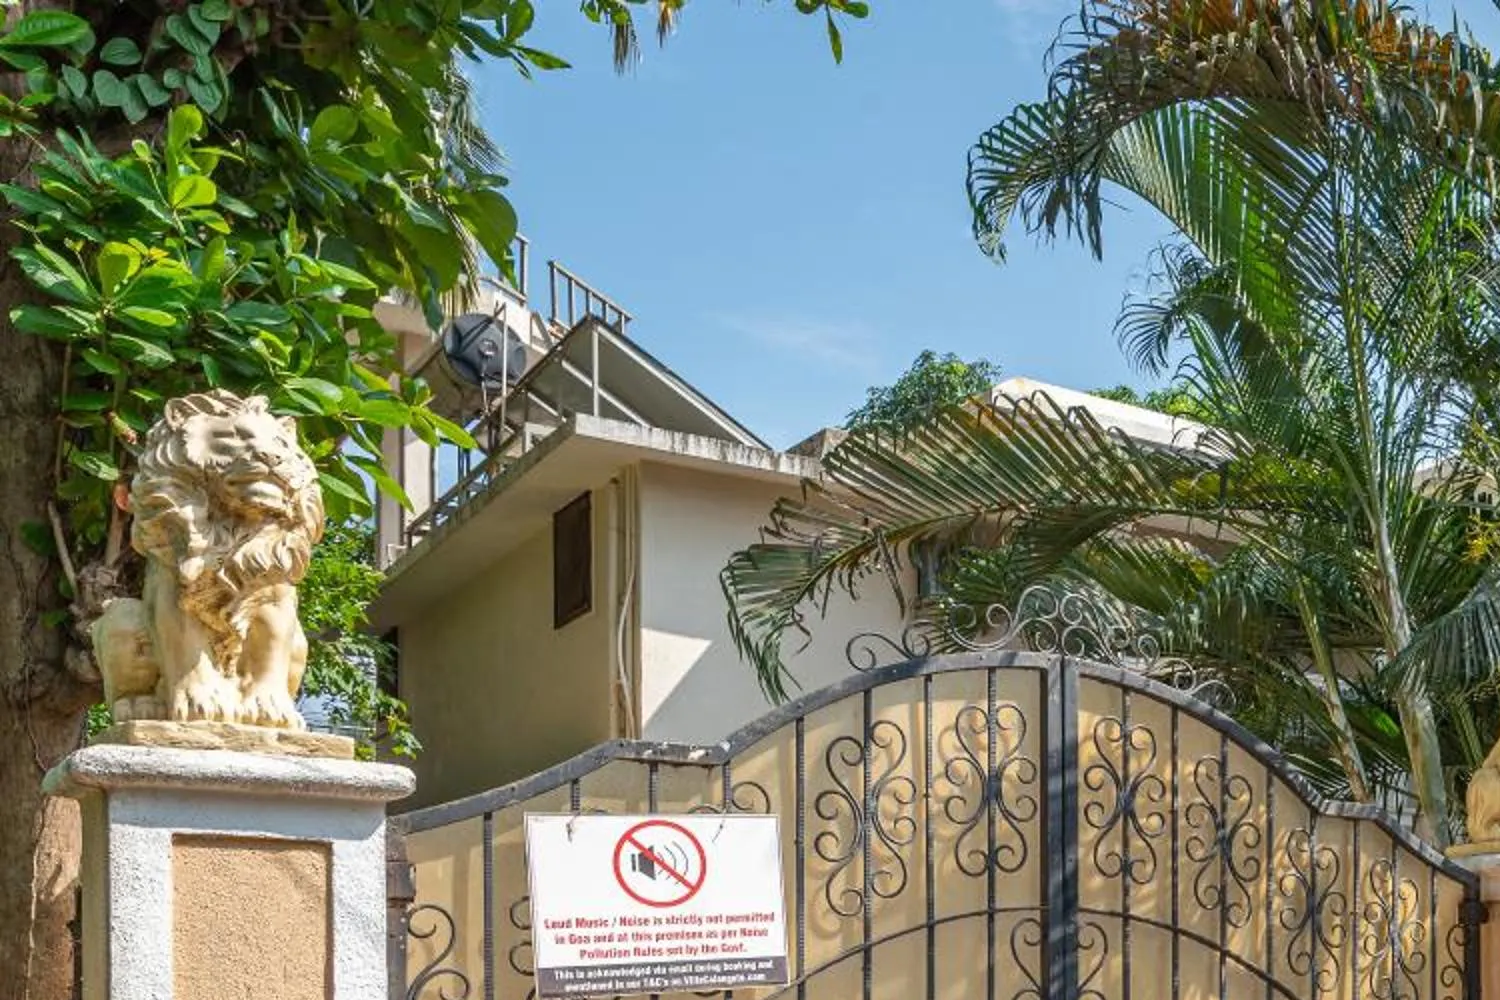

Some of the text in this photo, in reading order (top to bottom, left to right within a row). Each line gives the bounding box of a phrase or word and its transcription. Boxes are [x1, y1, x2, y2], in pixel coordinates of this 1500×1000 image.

[544, 917, 572, 929] Loud
[575, 917, 609, 928] Music
[619, 915, 650, 926] Noise
[653, 915, 662, 925] is
[665, 913, 703, 926] strictly
[706, 914, 723, 924] not
[725, 911, 775, 924] permitted
[555, 933, 565, 944] in
[568, 933, 591, 944] Goa
[593, 932, 615, 943] and
[617, 932, 629, 942] at
[632, 931, 652, 941] this
[655, 929, 703, 942] premises
[721, 929, 737, 940] per
[740, 927, 769, 937] Noise
[580, 947, 631, 960] Pollution
[633, 946, 664, 957] Rules
[686, 944, 699, 956] by
[702, 943, 718, 953] the
